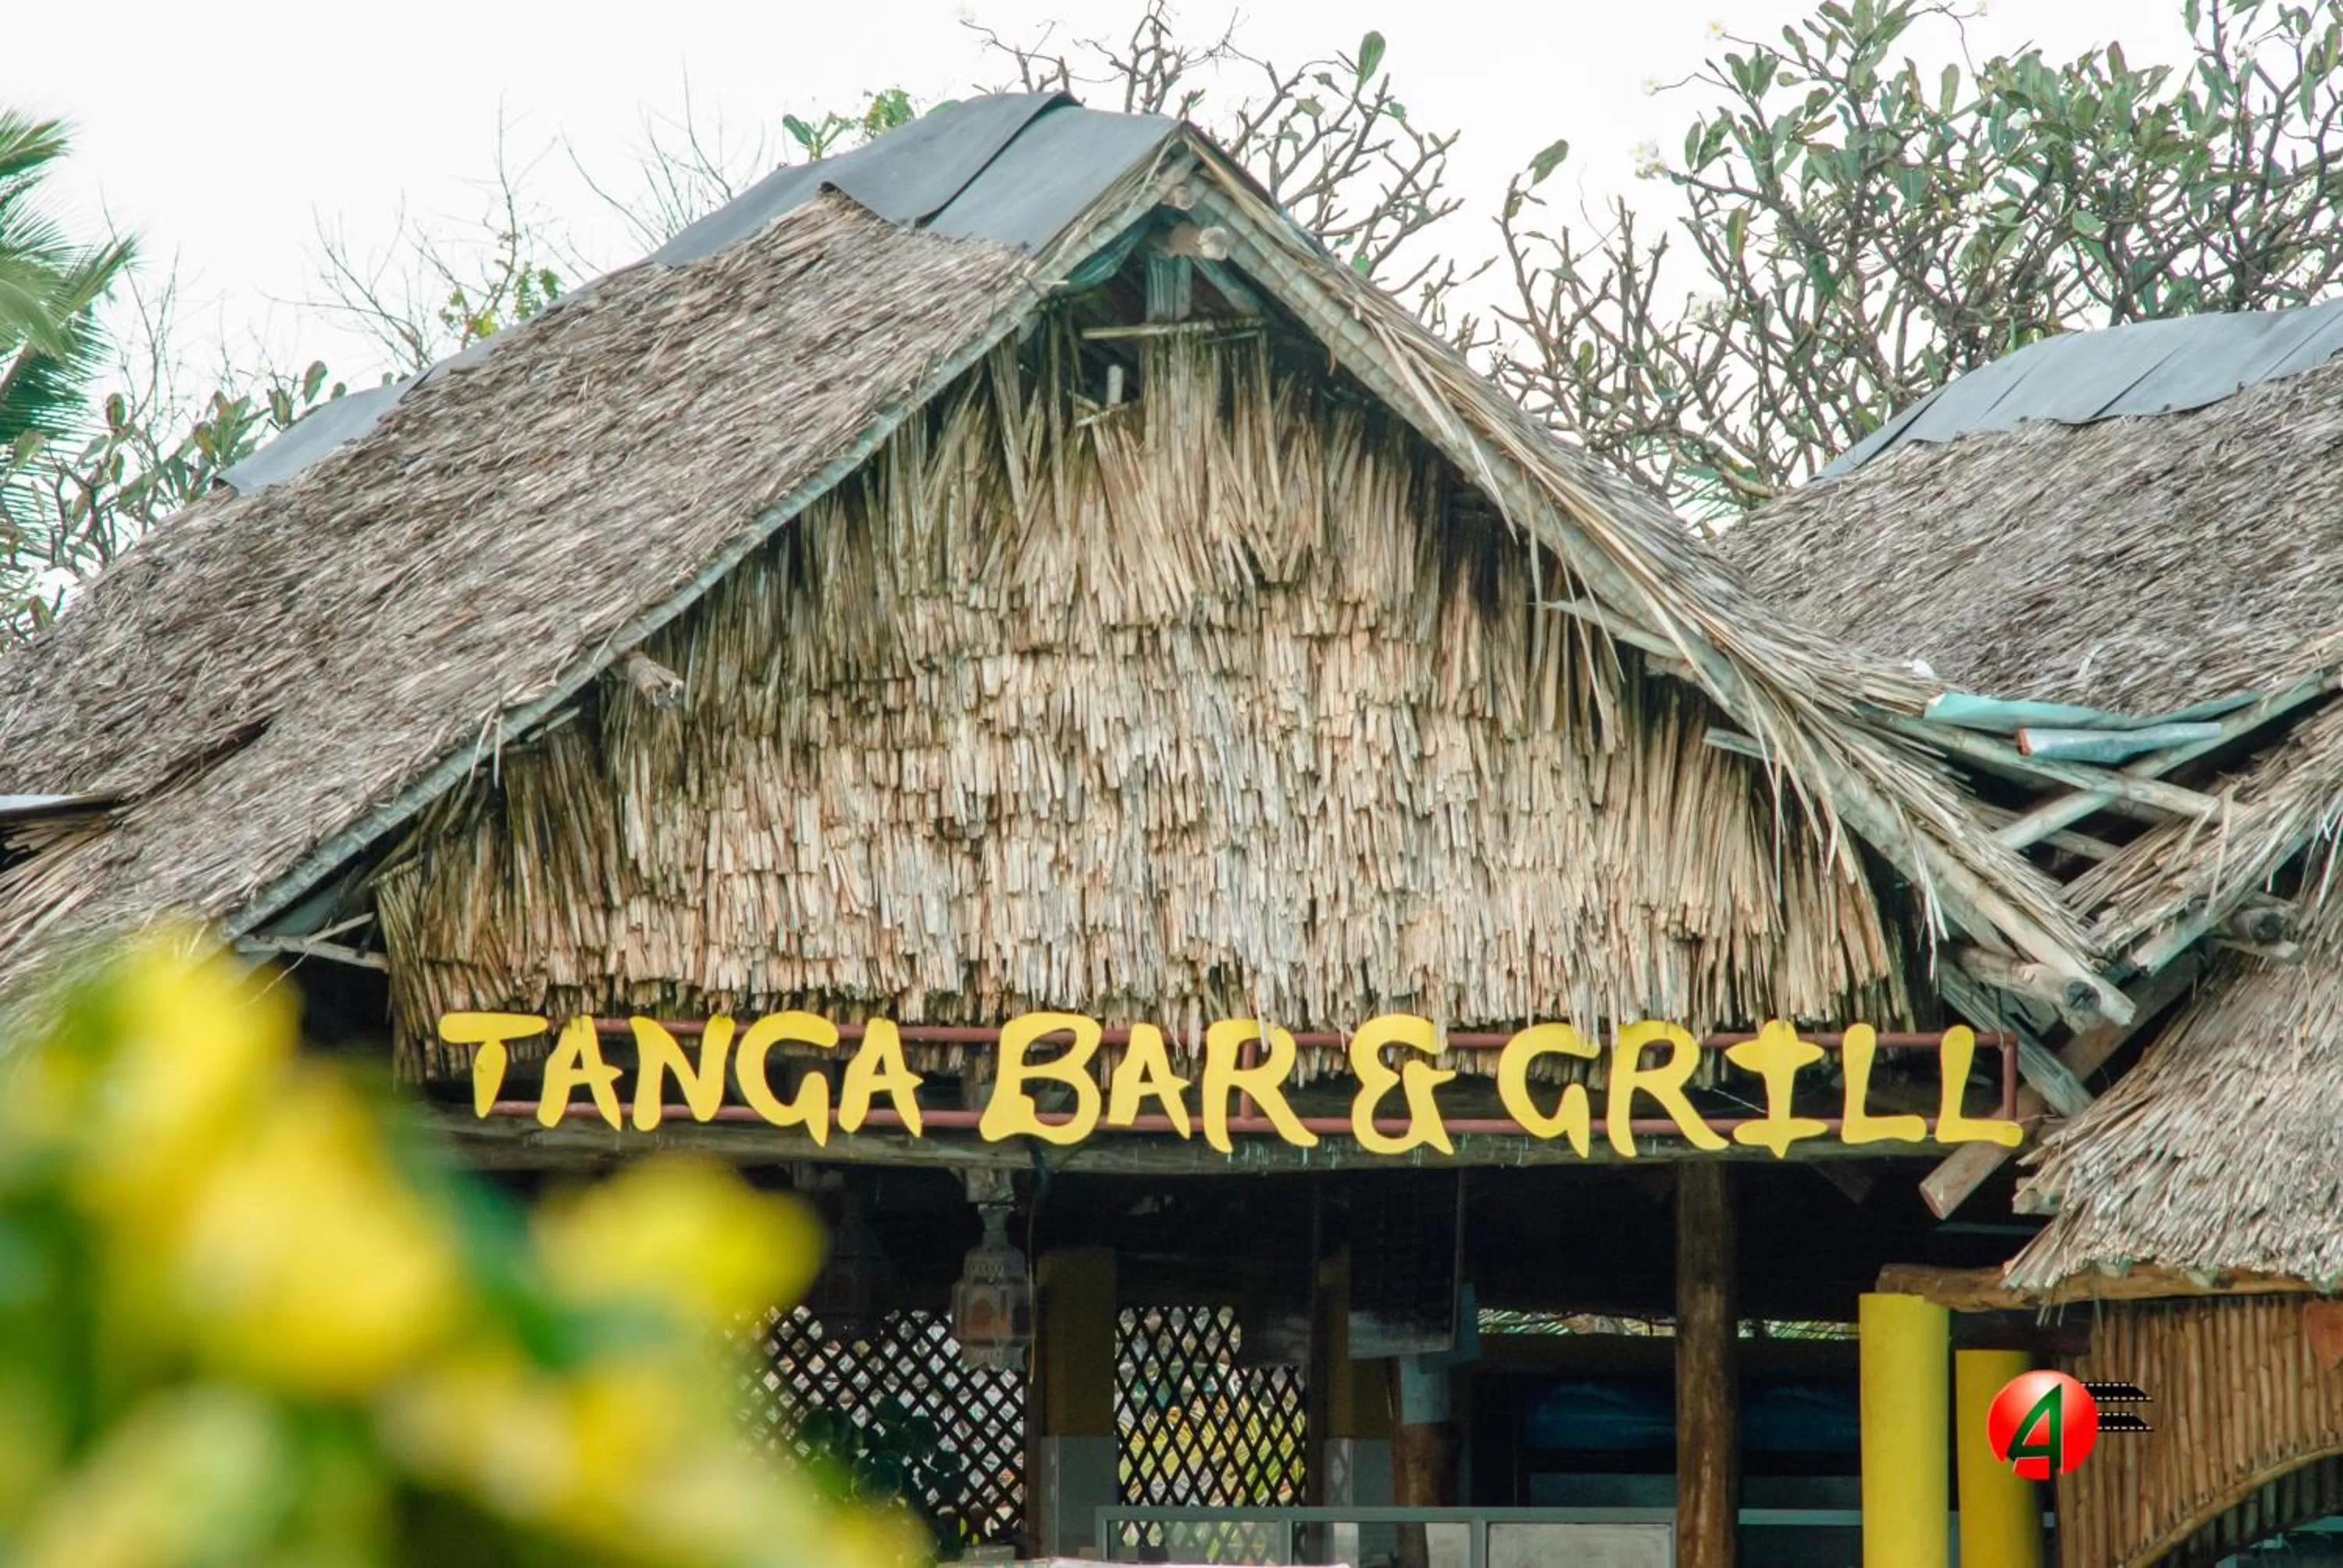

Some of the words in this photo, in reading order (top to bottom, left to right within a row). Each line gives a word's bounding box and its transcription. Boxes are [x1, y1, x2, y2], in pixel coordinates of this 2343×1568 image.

[438, 1010, 923, 1148] TANGA
[979, 1010, 1319, 1154] BAR
[1349, 1012, 1457, 1155] &
[1496, 1018, 2024, 1160] GRILL
